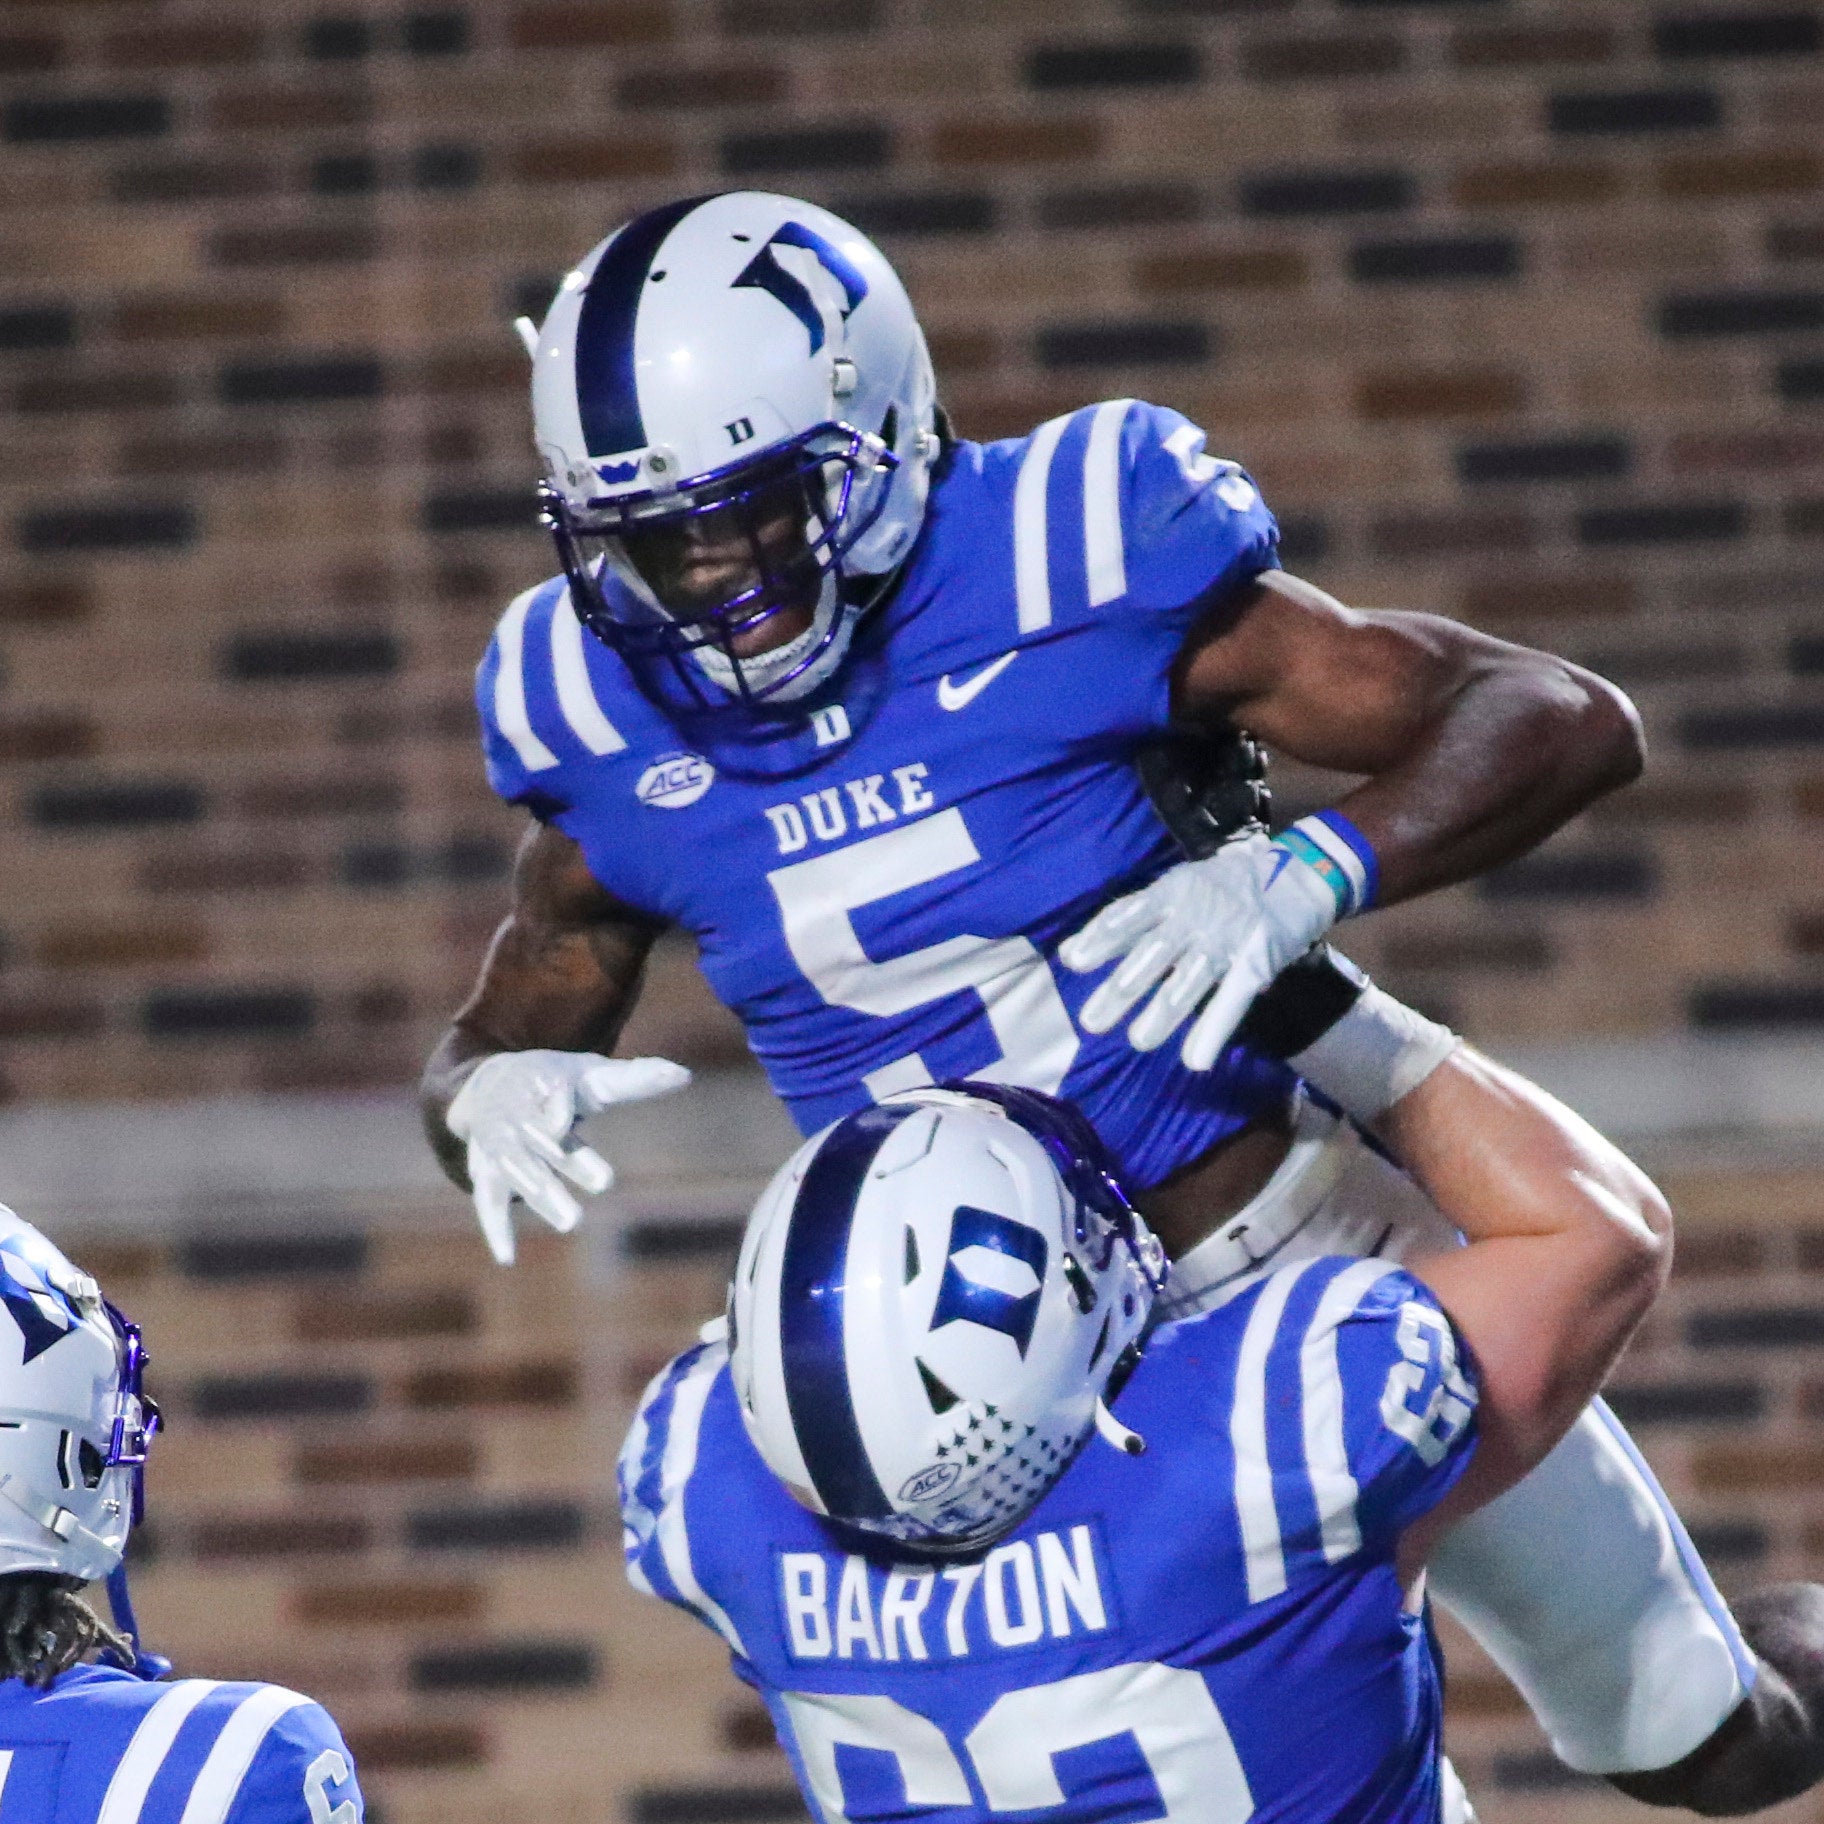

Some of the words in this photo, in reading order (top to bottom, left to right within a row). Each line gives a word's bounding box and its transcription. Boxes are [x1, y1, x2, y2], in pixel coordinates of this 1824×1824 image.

[723, 417, 756, 446] D
[809, 704, 851, 747] D
[647, 756, 705, 797] ACC
[763, 762, 934, 854] DUKE
[767, 806, 1081, 1100] 5
[782, 1525, 1108, 1661] BARTON
